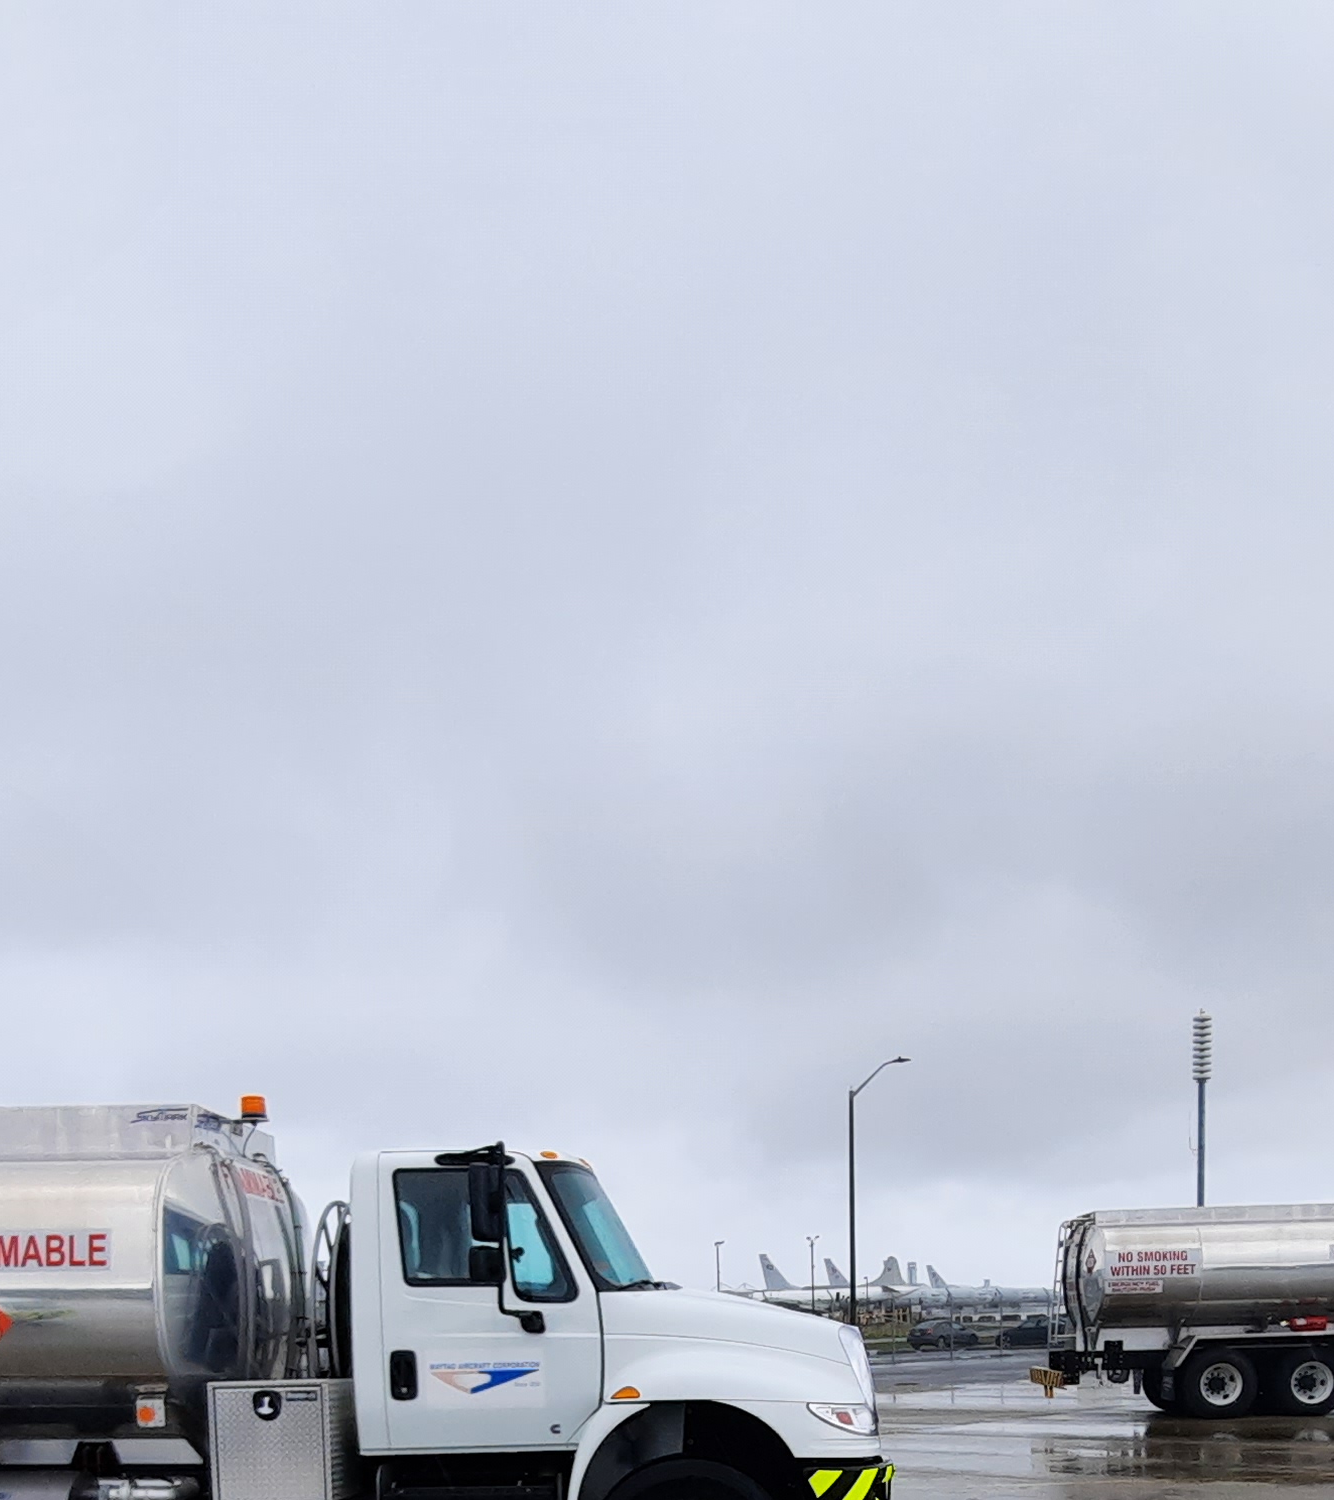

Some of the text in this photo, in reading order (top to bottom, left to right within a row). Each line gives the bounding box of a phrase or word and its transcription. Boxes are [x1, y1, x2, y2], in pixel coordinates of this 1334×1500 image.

[1118, 1251, 1188, 1263] NO SMOKING
[1110, 1264, 1196, 1276] WITHIN 50 FEET
